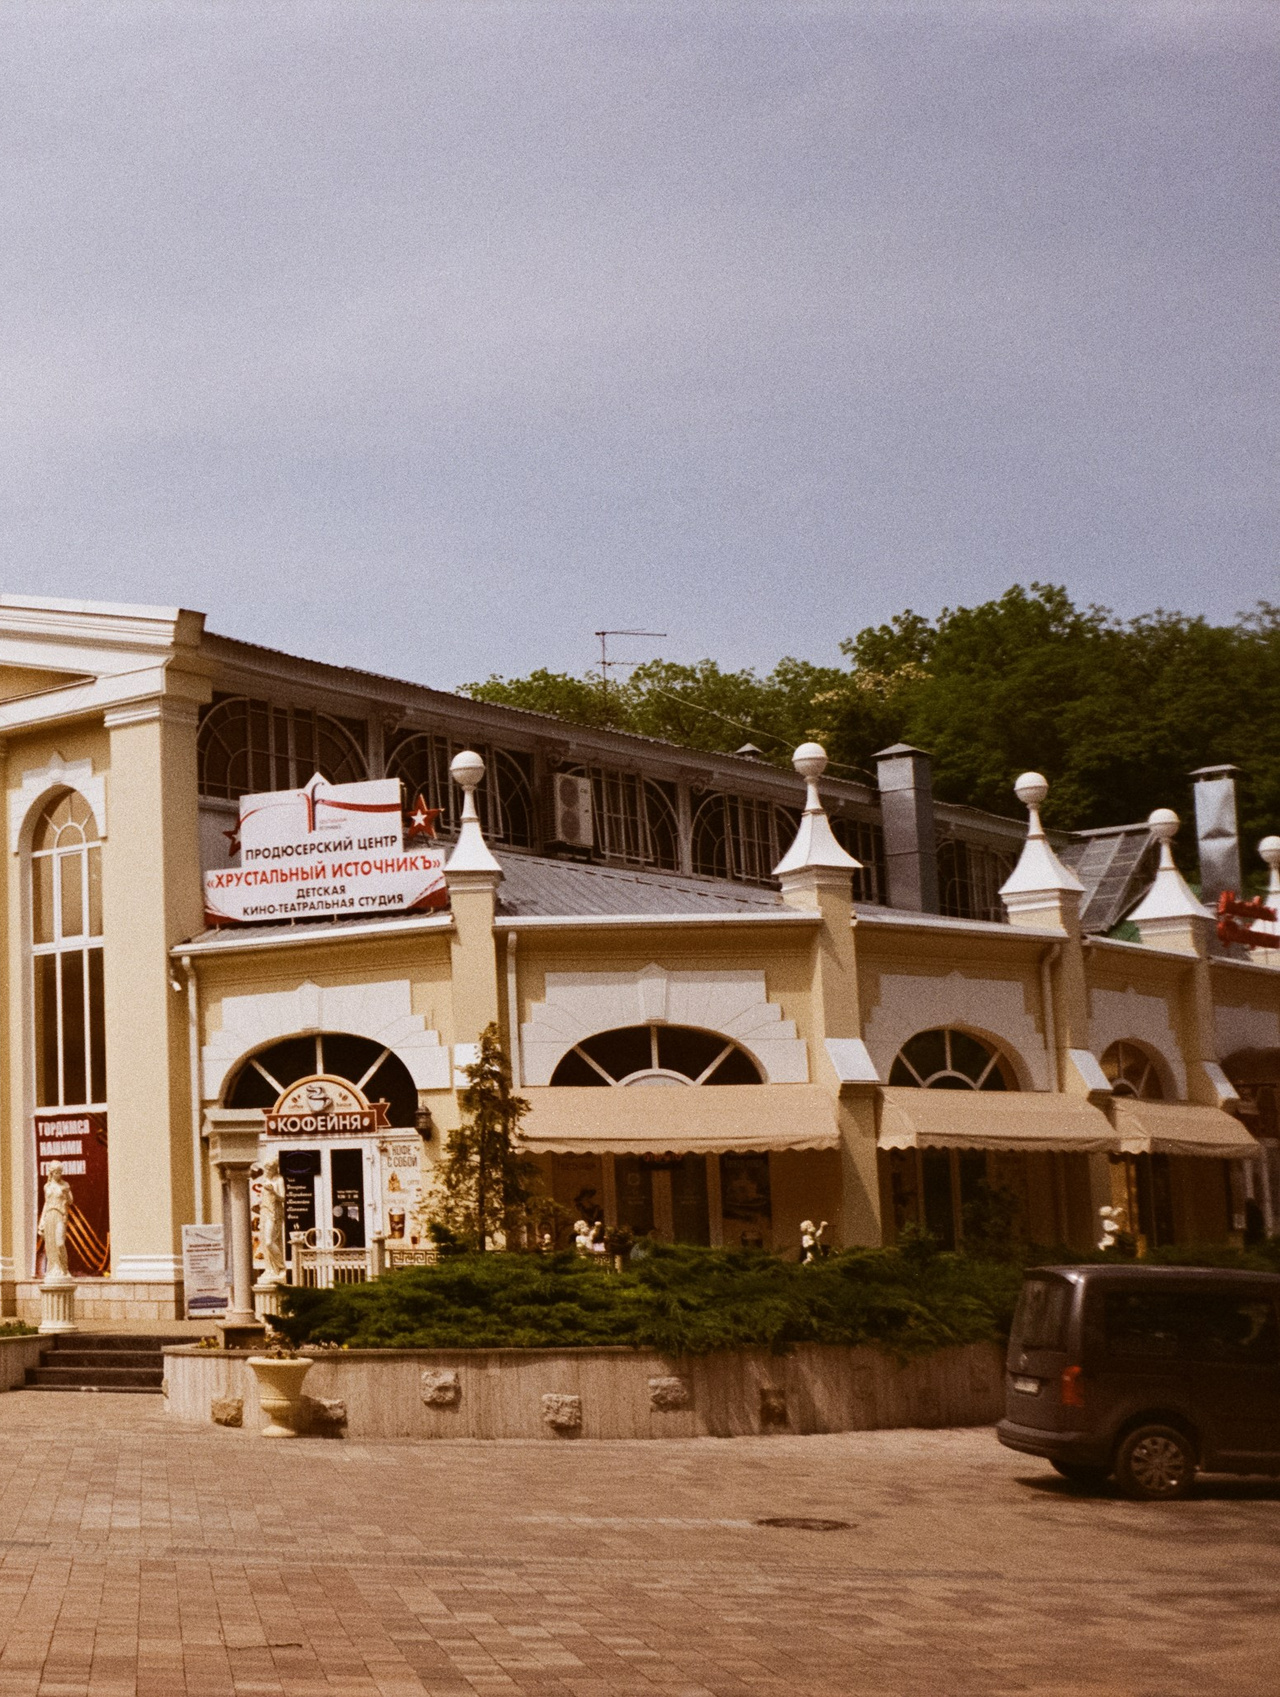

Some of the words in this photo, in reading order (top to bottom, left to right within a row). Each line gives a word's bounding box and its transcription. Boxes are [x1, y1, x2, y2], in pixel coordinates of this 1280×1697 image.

[245, 836, 353, 861] ПРОДЮСЕРСКИЙ
[358, 835, 398, 851] ЦЕНТР
[206, 861, 326, 888] «ХРУСТАЛЬНЫЙ
[332, 855, 441, 878] ИСТОЧНИКЪ»
[296, 885, 346, 899] ДЕТСКАЯ
[243, 898, 354, 916] КИНО-ТЕАТРАЛЬНАЯ
[358, 894, 404, 907] СТУДИЯ
[277, 1113, 362, 1133] КОФЕЙНЯ
[392, 1145, 411, 1155] КОФЕ
